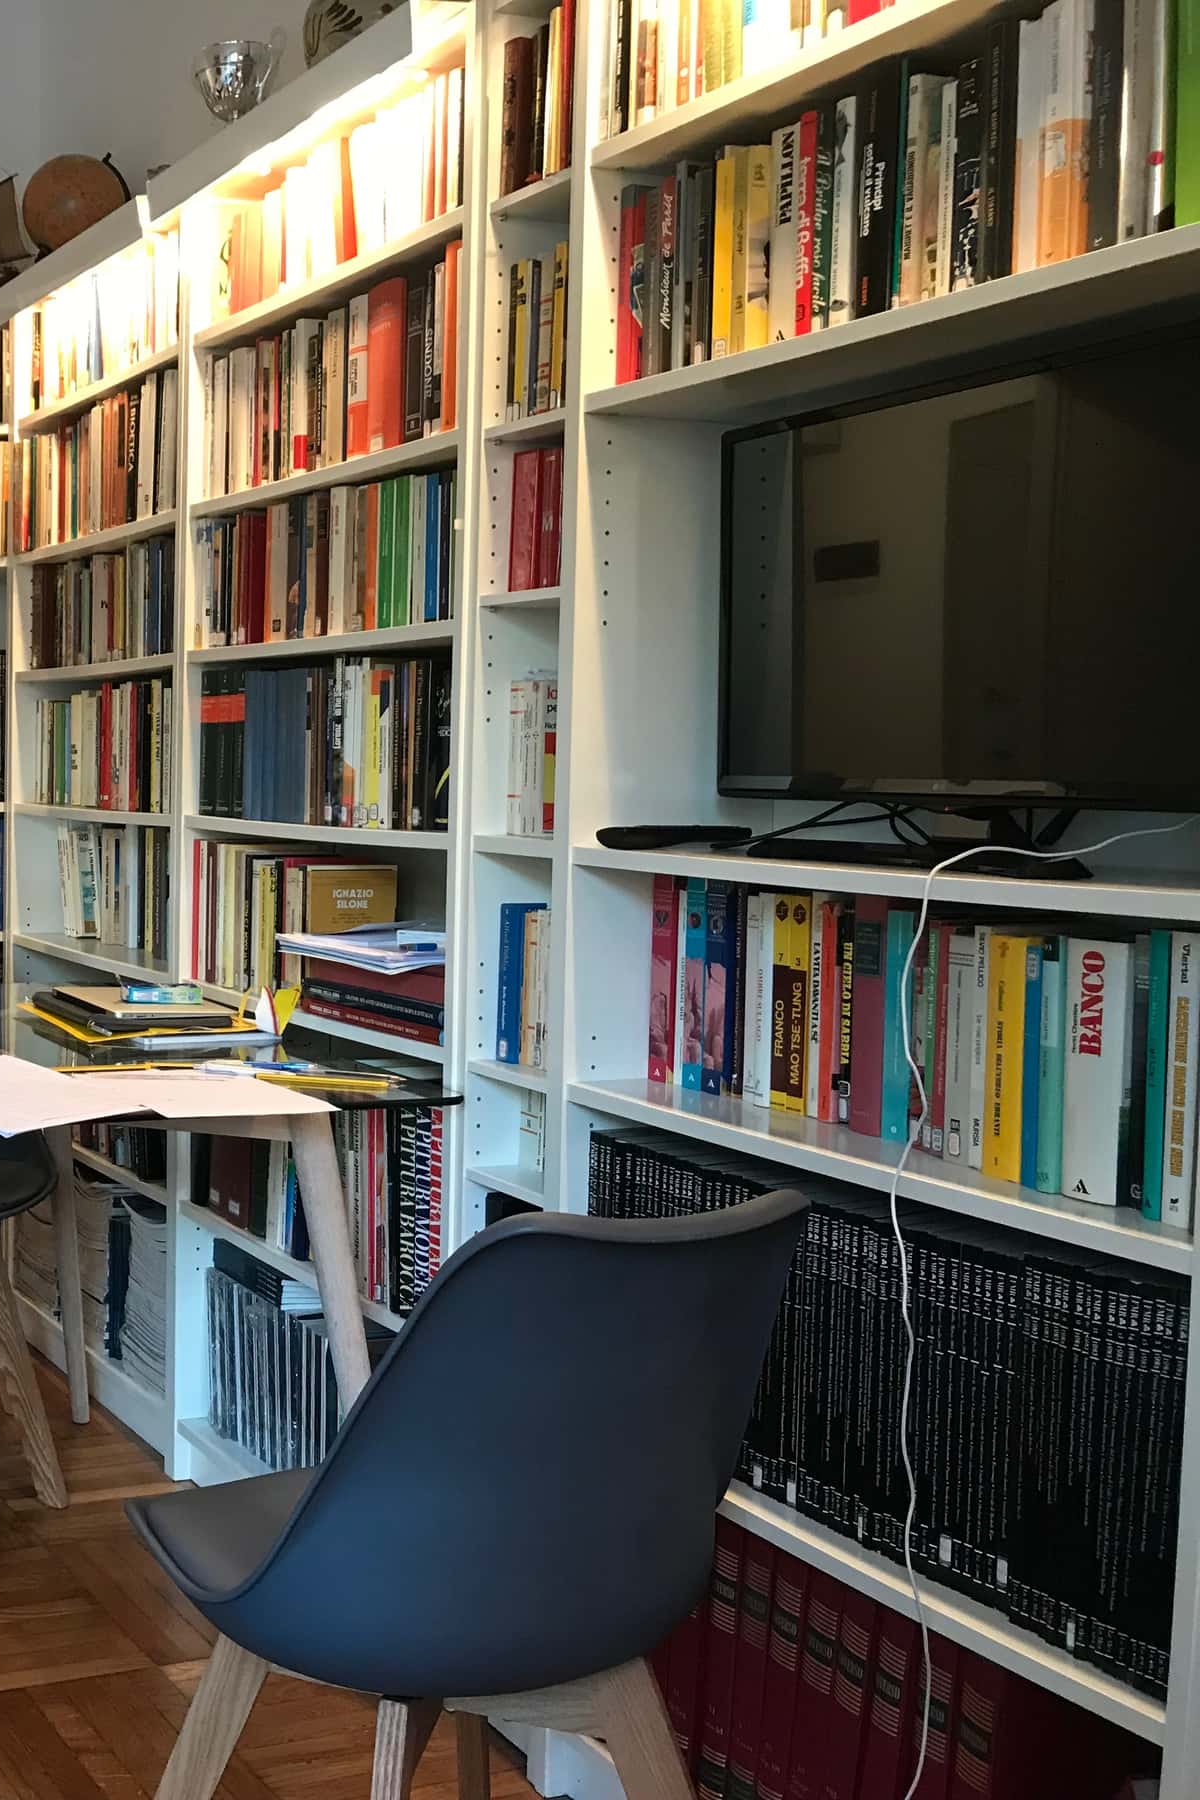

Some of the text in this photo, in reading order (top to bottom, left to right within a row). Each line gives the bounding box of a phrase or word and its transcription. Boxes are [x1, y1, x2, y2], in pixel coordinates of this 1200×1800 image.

[778, 131, 795, 225] PAPILLON
[863, 143, 874, 177] sotto
[873, 161, 886, 212] Principi
[862, 187, 873, 238] vulcano
[659, 192, 675, 330] Monsieur de Paris
[424, 327, 433, 400] SINDONE
[128, 407, 136, 472] BIOETICA
[332, 723, 342, 750] Lorenz
[332, 888, 374, 899] IGNAZIO
[336, 900, 368, 909] SILONE
[777, 952, 784, 963] 7
[812, 956, 821, 978] VITA
[813, 941, 822, 955] LA
[842, 942, 853, 960] UN
[1179, 943, 1191, 984] Viertel
[841, 962, 853, 1000] CIELO
[976, 956, 985, 988] PELLICO
[811, 979, 821, 1020] DAVANTI
[841, 1002, 852, 1016] DI
[1078, 950, 1106, 1057] BANCO
[774, 1000, 785, 1057] FRANCO
[790, 982, 802, 1086] MAO TSE-TUNG
[971, 1118, 980, 1147] MURSIA
[399, 1124, 415, 1207] PITTURA
[415, 1129, 431, 1212] PITTURA
[398, 1212, 415, 1312] BAROCCA
